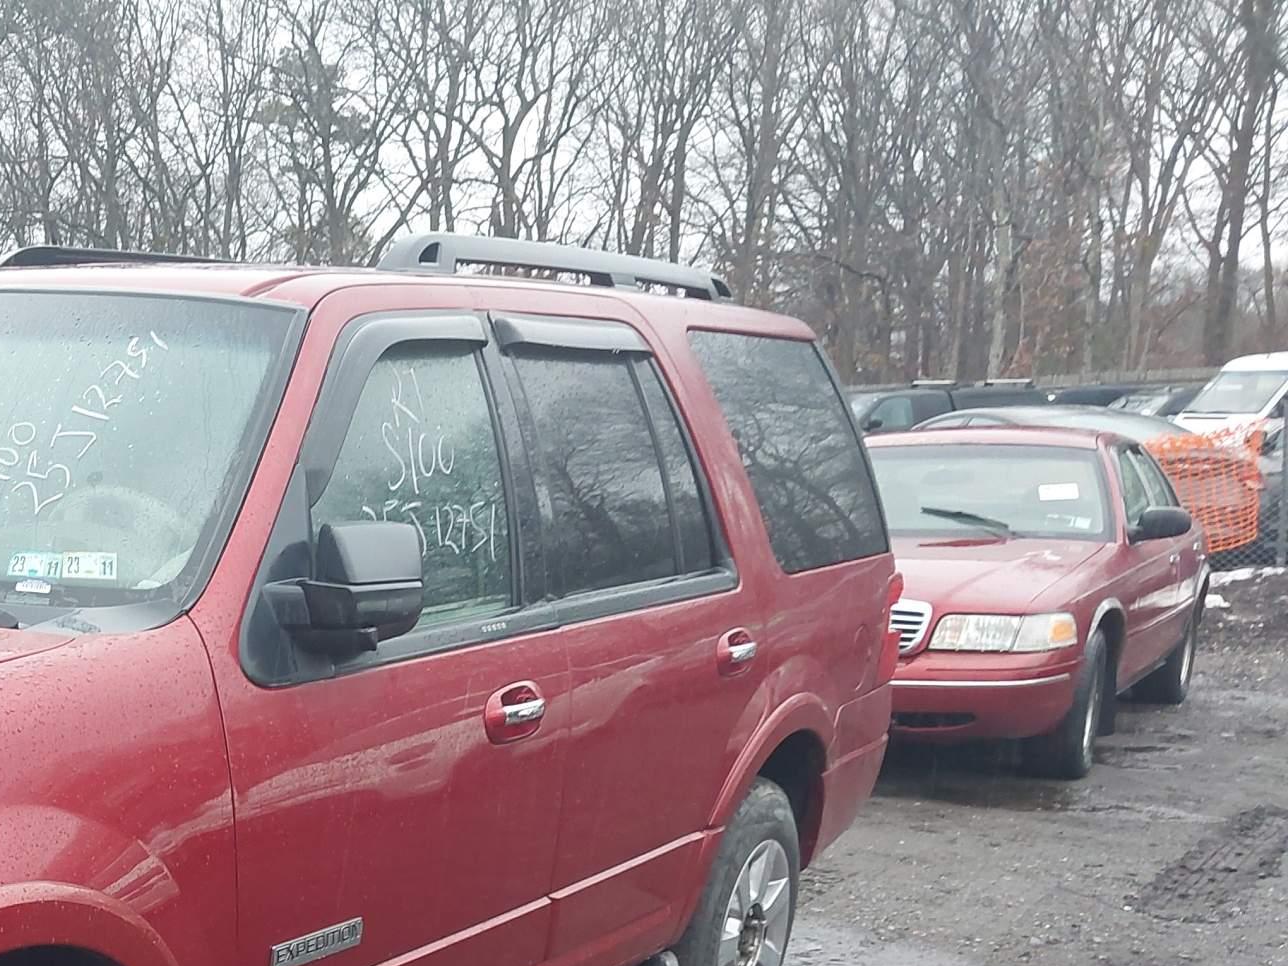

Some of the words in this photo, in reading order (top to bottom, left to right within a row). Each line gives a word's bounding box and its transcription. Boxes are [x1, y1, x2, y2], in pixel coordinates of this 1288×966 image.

[381, 421, 455, 494] S100
[12, 555, 26, 573] 23
[67, 556, 80, 574] 23
[276, 920, 361, 964] EXPEDITION
